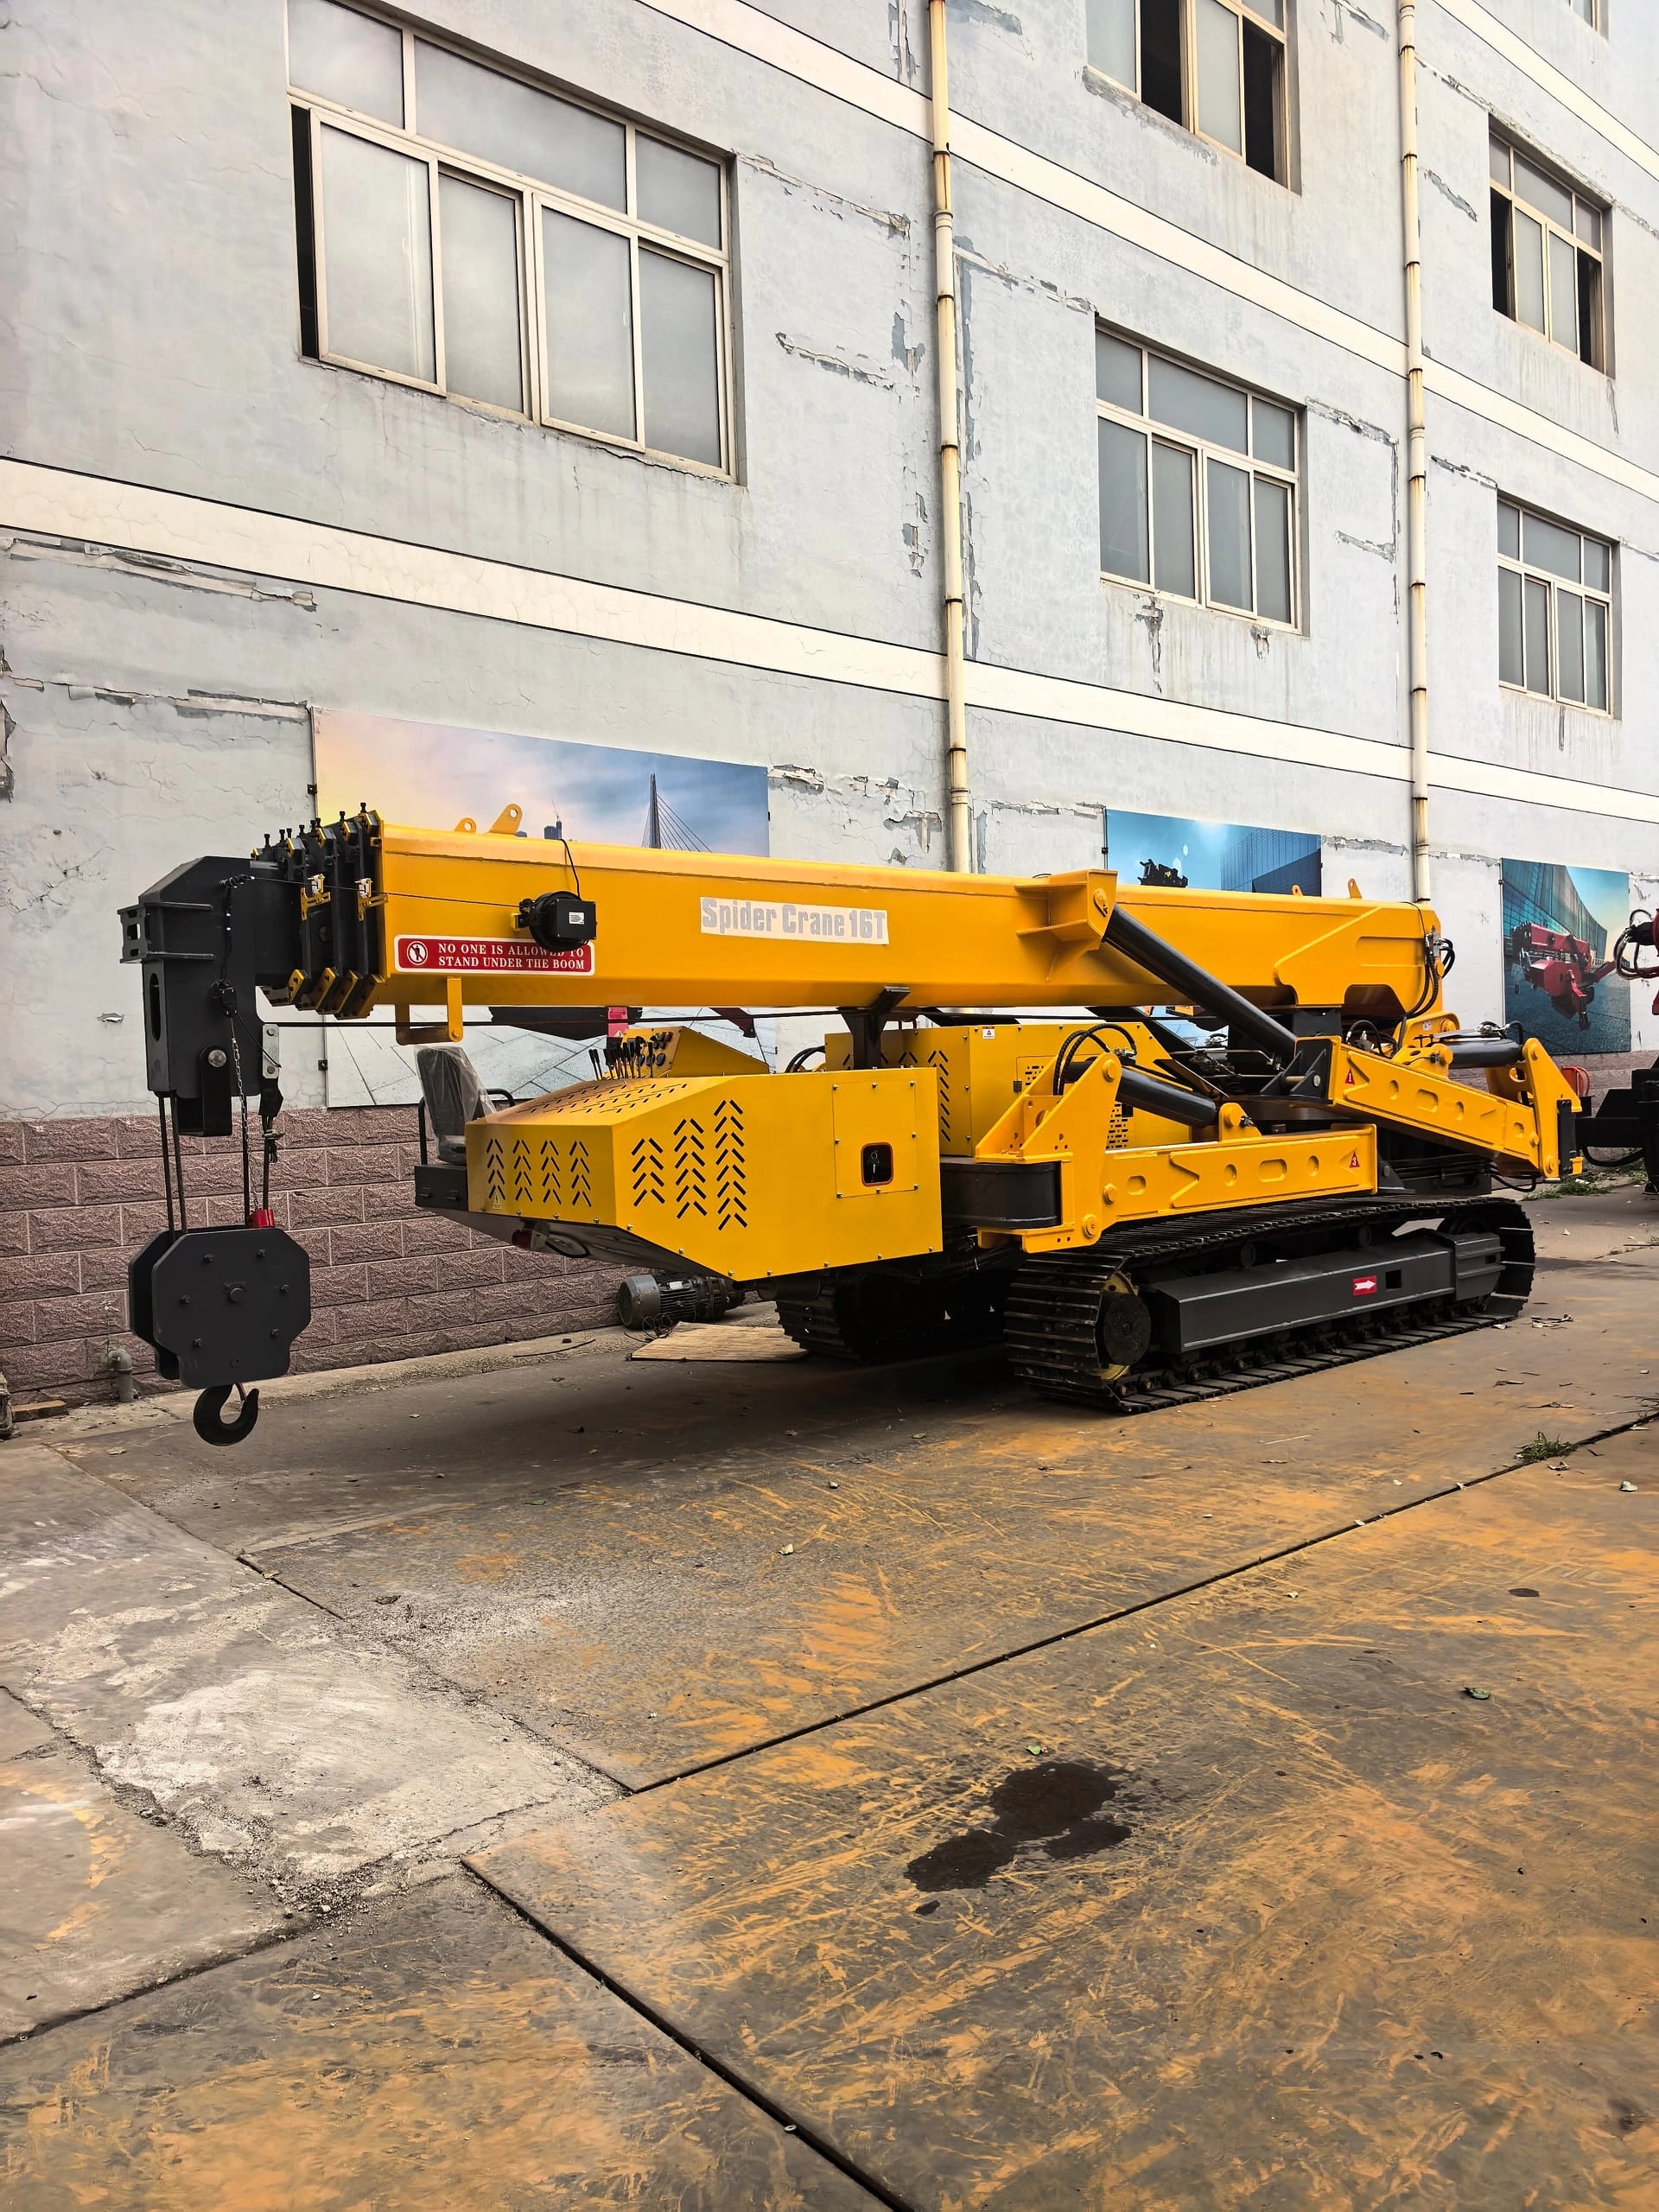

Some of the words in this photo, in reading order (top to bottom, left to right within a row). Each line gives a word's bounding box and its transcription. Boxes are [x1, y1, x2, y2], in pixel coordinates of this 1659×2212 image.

[702, 898, 777, 934] Spider
[782, 904, 845, 937] Crane
[849, 910, 886, 939] 16T
[438, 943, 456, 953] NO
[461, 944, 486, 954] ONE
[491, 944, 503, 955] IS
[570, 948, 584, 957] TO
[438, 956, 480, 967] STAND
[483, 957, 523, 968] UNDER
[525, 958, 549, 969] THE
[552, 959, 585, 969] BOOM
[1351, 1156, 1357, 1166] 3
